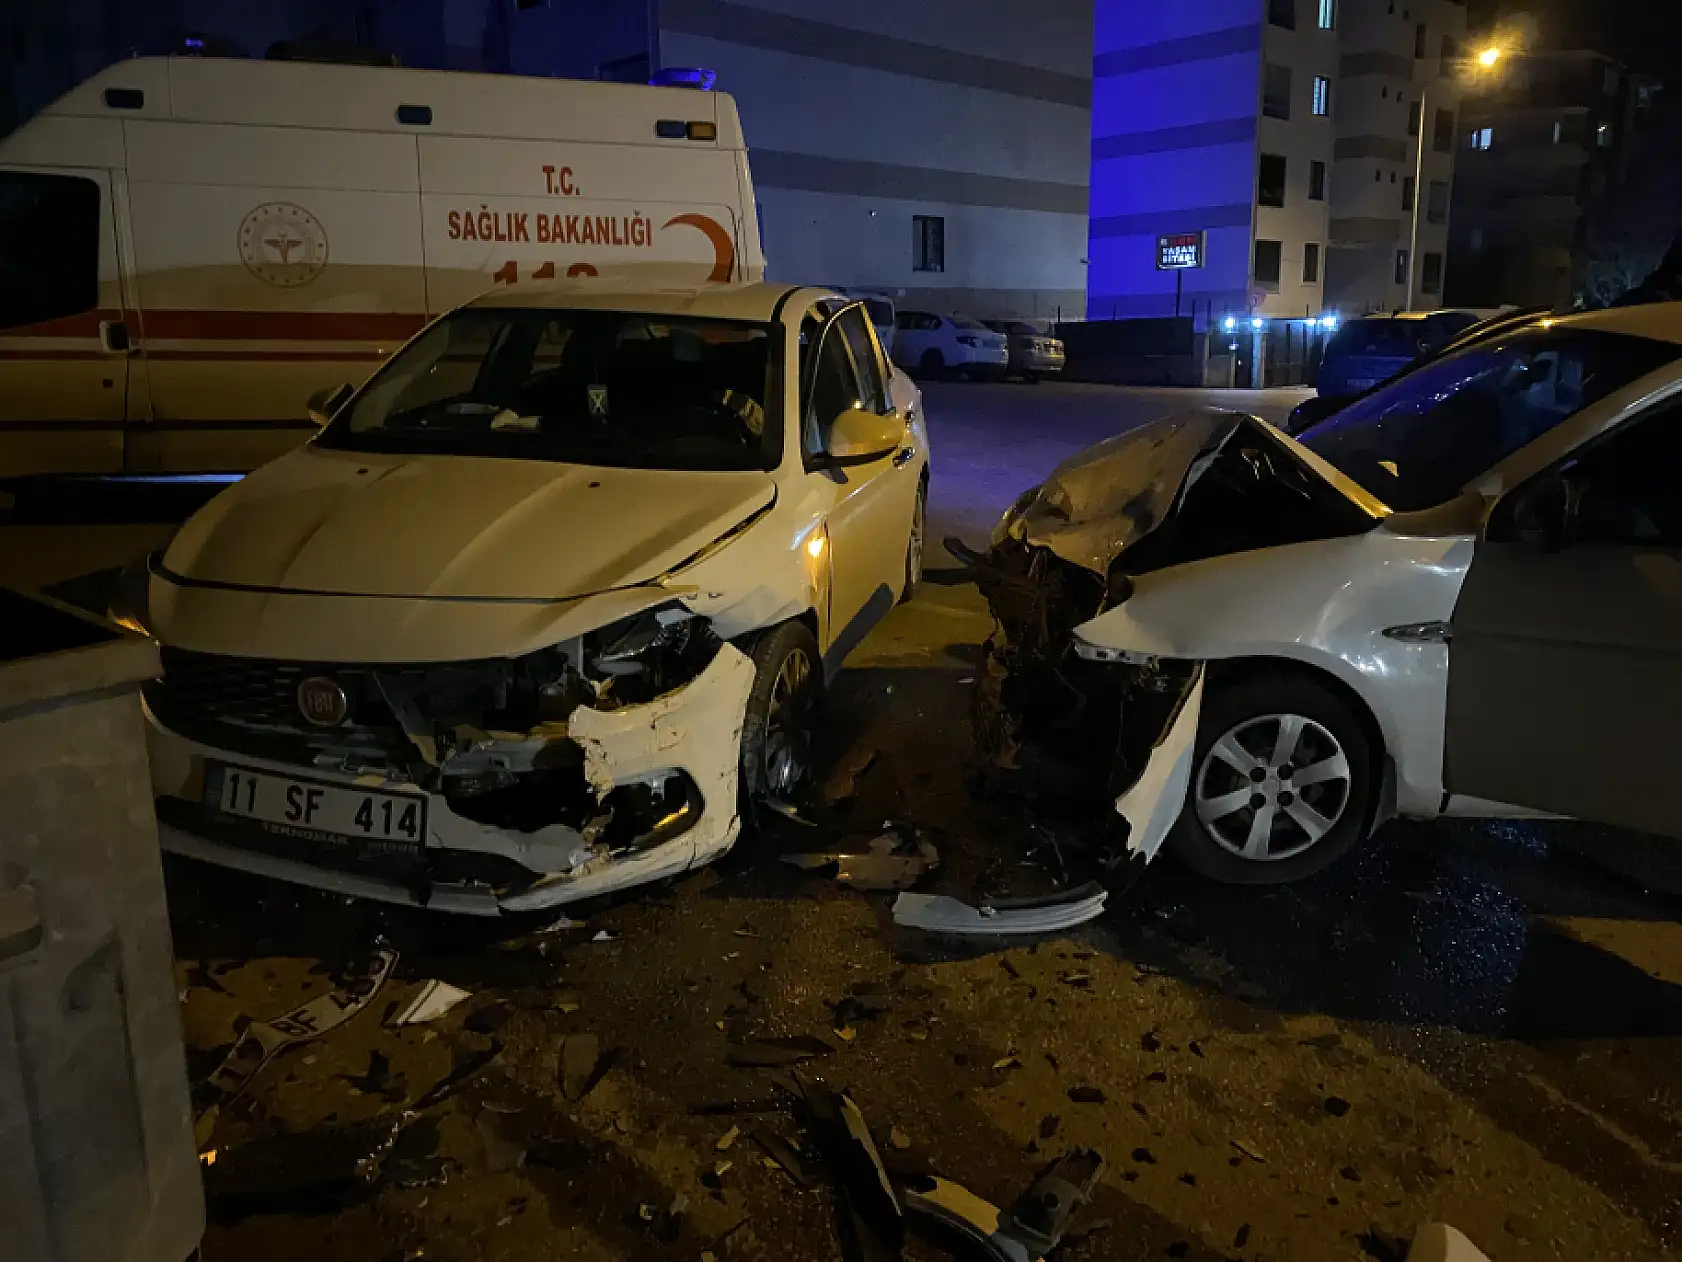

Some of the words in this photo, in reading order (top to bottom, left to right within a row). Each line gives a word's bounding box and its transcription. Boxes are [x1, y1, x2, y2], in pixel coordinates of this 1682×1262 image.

[542, 165, 581, 195] T.C.
[448, 204, 530, 243] SAĞLIK
[537, 209, 653, 247] BAKANLIĞI
[229, 773, 257, 812] 11
[284, 785, 325, 824] SF
[354, 797, 417, 838] 414
